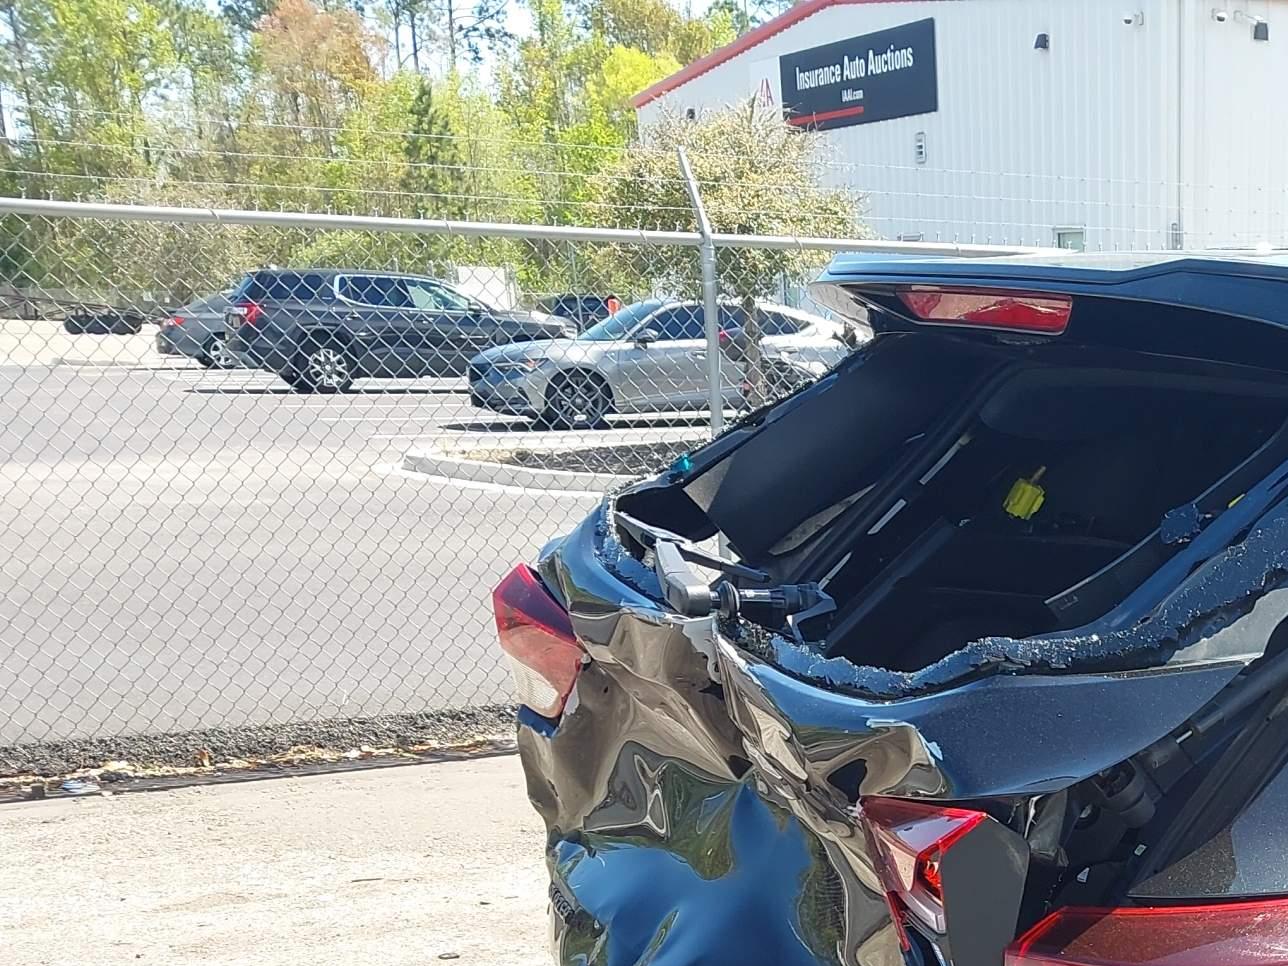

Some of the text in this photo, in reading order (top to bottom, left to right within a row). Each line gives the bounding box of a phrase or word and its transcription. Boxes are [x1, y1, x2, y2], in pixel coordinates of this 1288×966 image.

[796, 44, 914, 90] Insurance Auto Auctions
